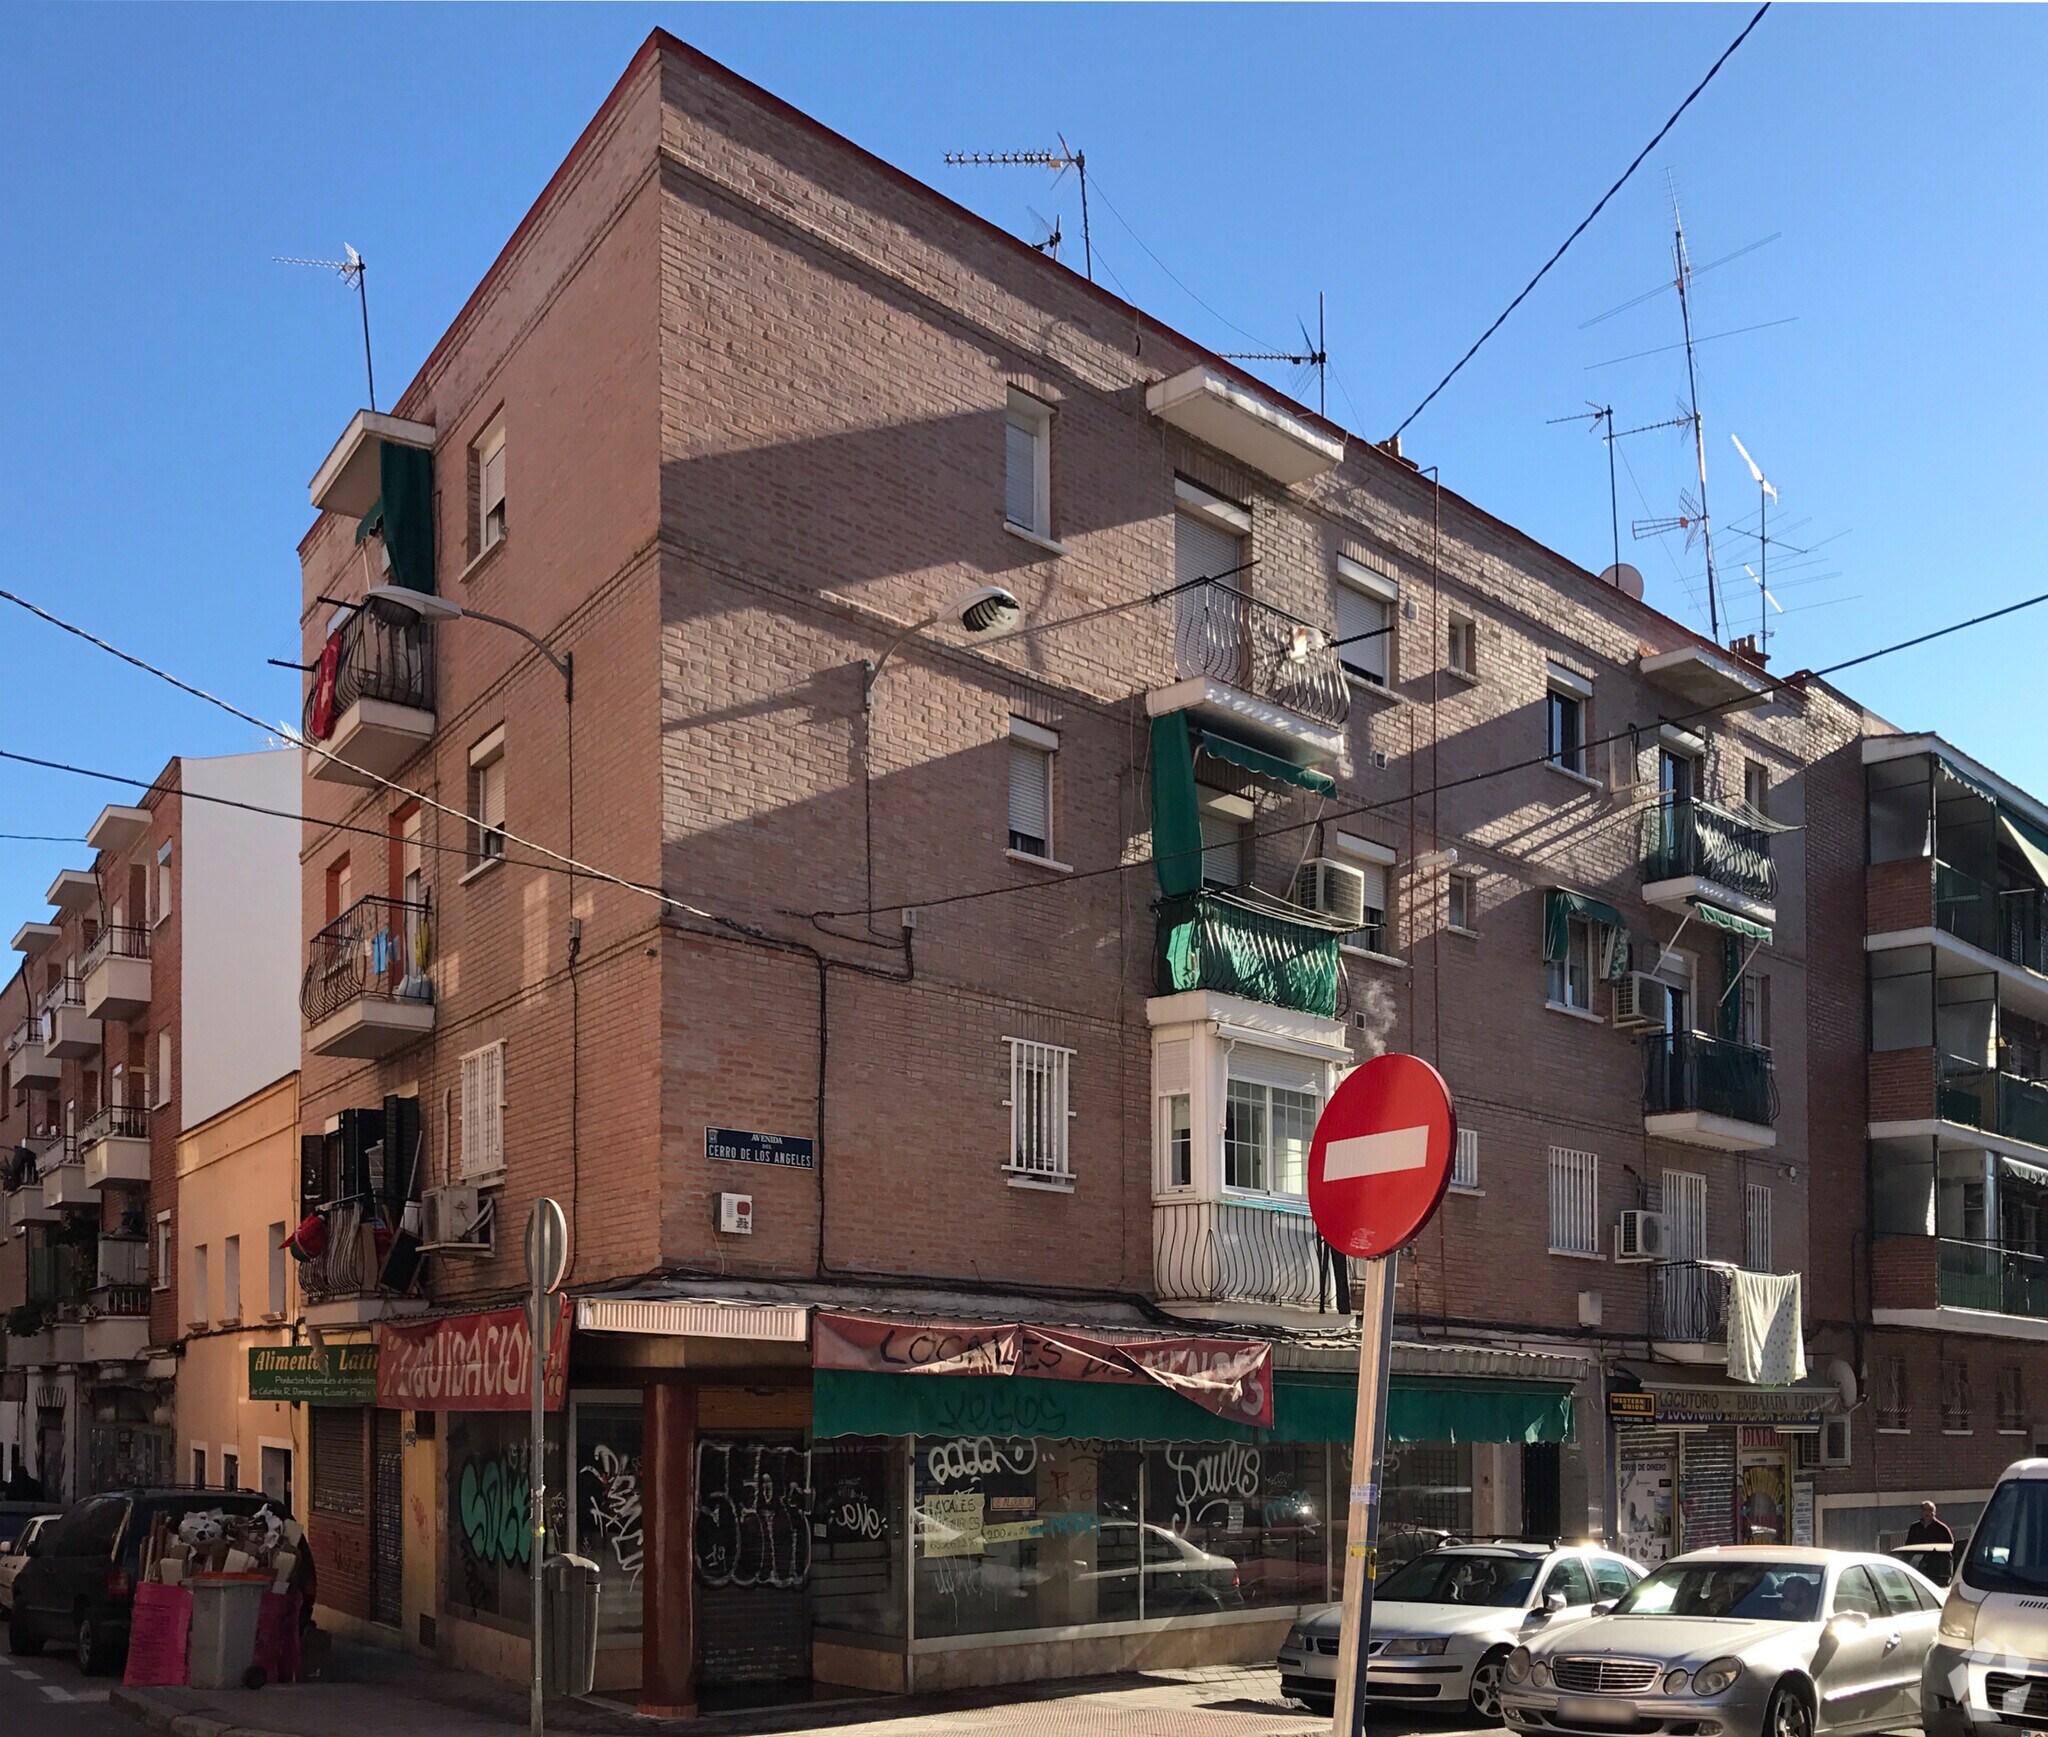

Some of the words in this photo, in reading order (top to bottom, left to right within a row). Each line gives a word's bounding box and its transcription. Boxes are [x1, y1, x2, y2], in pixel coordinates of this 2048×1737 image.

[751, 1133, 783, 1144] AVENIDA
[708, 1145, 736, 1158] CERRO
[740, 1148, 751, 1160] DE
[755, 1149, 770, 1162] LOS
[774, 1152, 811, 1167] ANGELES
[880, 1328, 1062, 1370] LOCALES
[1660, 1391, 1719, 1410] LOCUTORIO
[1738, 1394, 1788, 1411] EMBAJADA
[1743, 1428, 1783, 1447] DINERO
[1638, 1463, 1645, 1471] DE
[1646, 1463, 1667, 1471] DINERO
